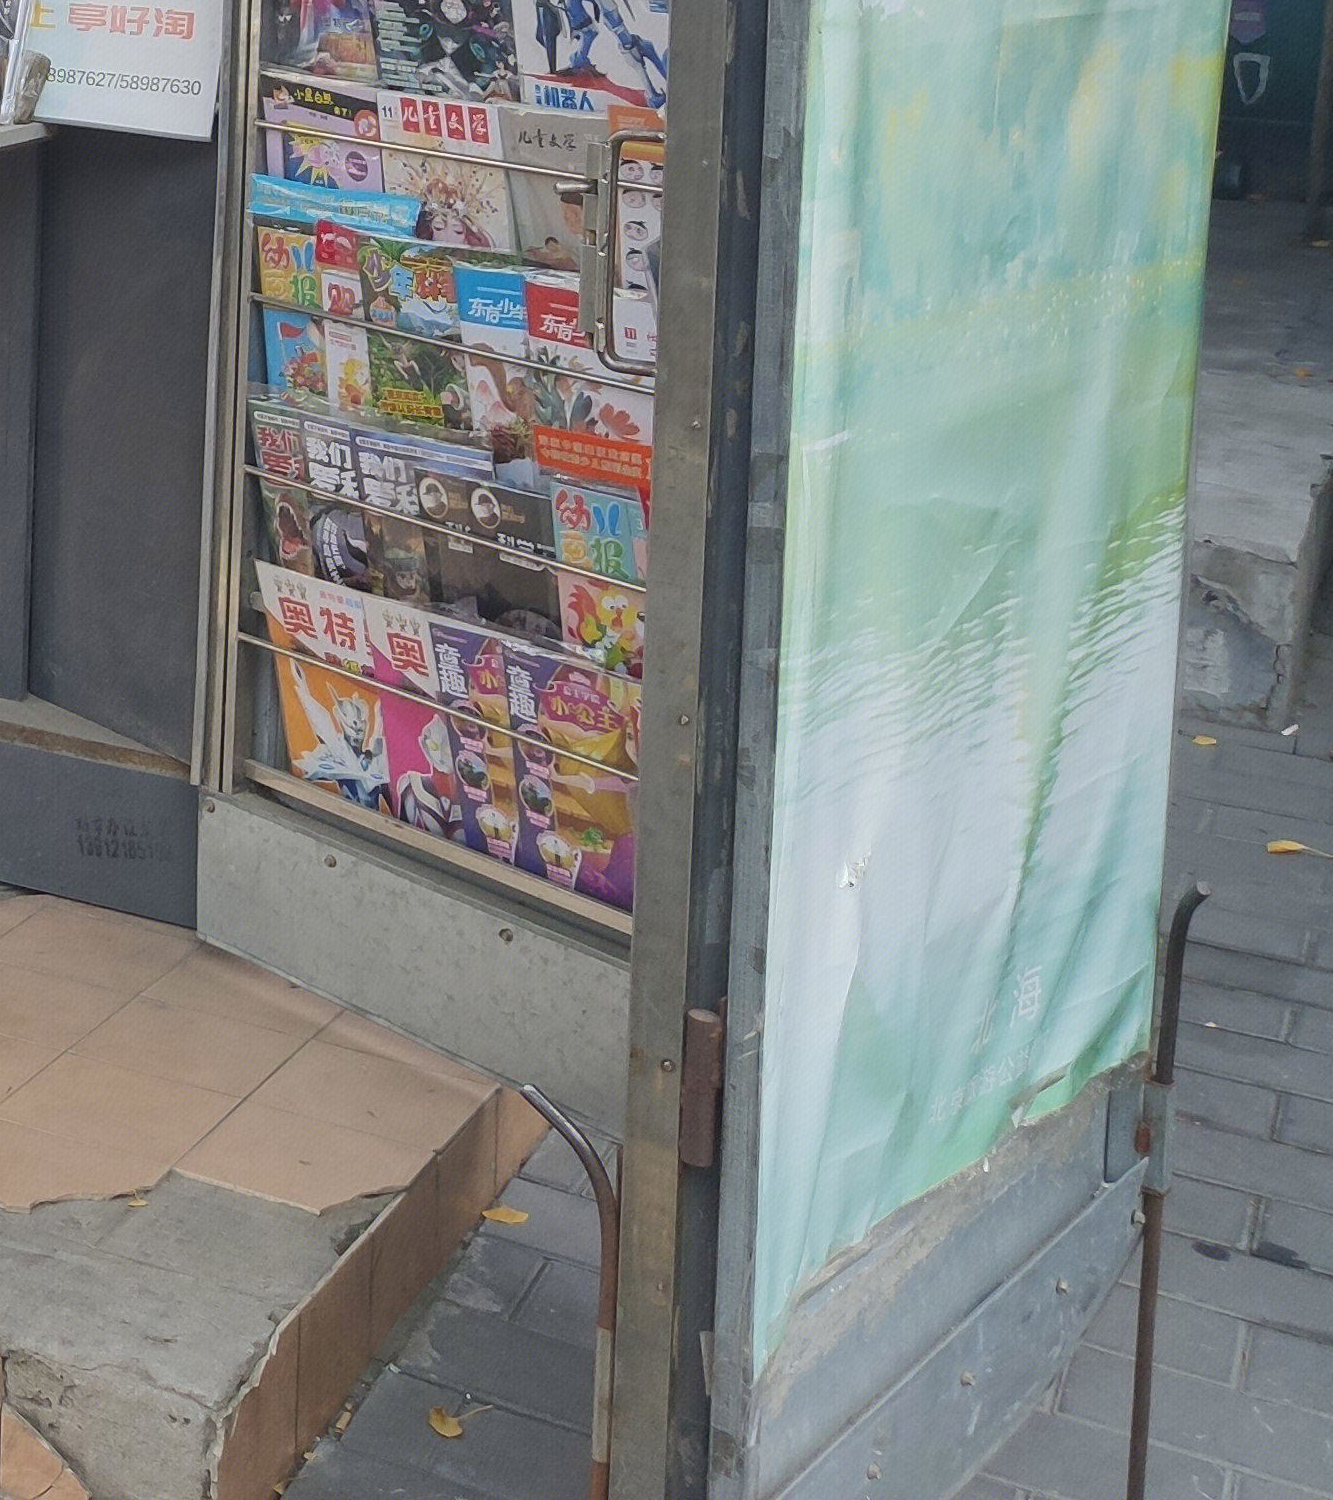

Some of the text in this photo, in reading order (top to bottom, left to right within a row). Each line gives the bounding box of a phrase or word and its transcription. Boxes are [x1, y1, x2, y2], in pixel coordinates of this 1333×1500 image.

[381, 102, 488, 136] 11 儿童文学
[518, 128, 577, 151] 儿童文学
[305, 436, 353, 470] 我们
[358, 452, 408, 484] 我们
[555, 488, 622, 537] 幼儿
[277, 596, 357, 652] 奥特
[386, 631, 430, 678] 奥
[505, 664, 538, 724] 童趣
